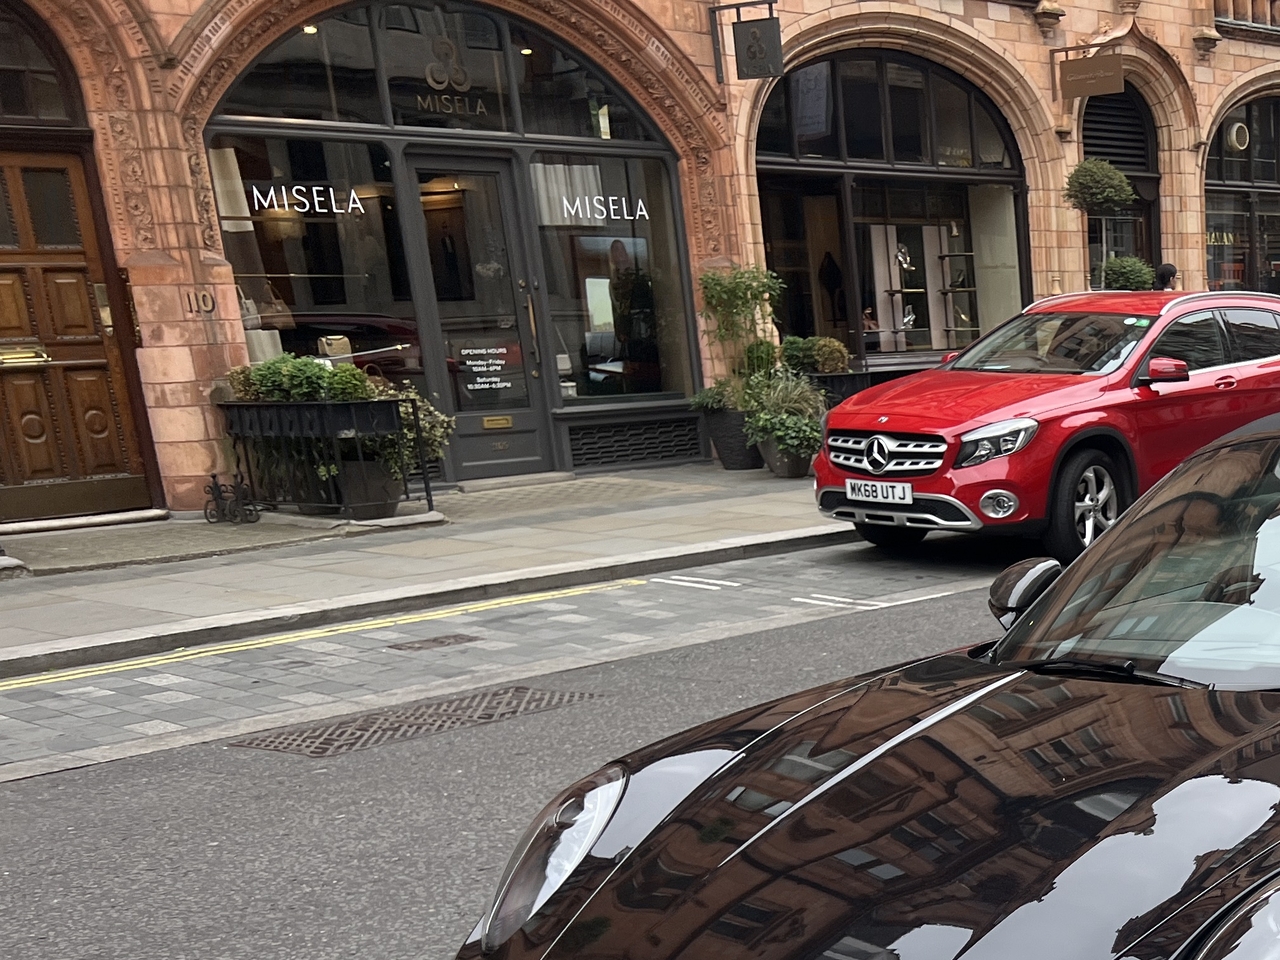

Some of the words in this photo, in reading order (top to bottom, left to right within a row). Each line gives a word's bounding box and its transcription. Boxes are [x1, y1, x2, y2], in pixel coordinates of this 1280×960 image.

[416, 94, 488, 116] MISELA
[252, 184, 365, 214] MISELA
[562, 195, 649, 220] MISELA
[186, 290, 216, 314] 110
[850, 482, 878, 498] MK68
[880, 485, 906, 500] UTJ
